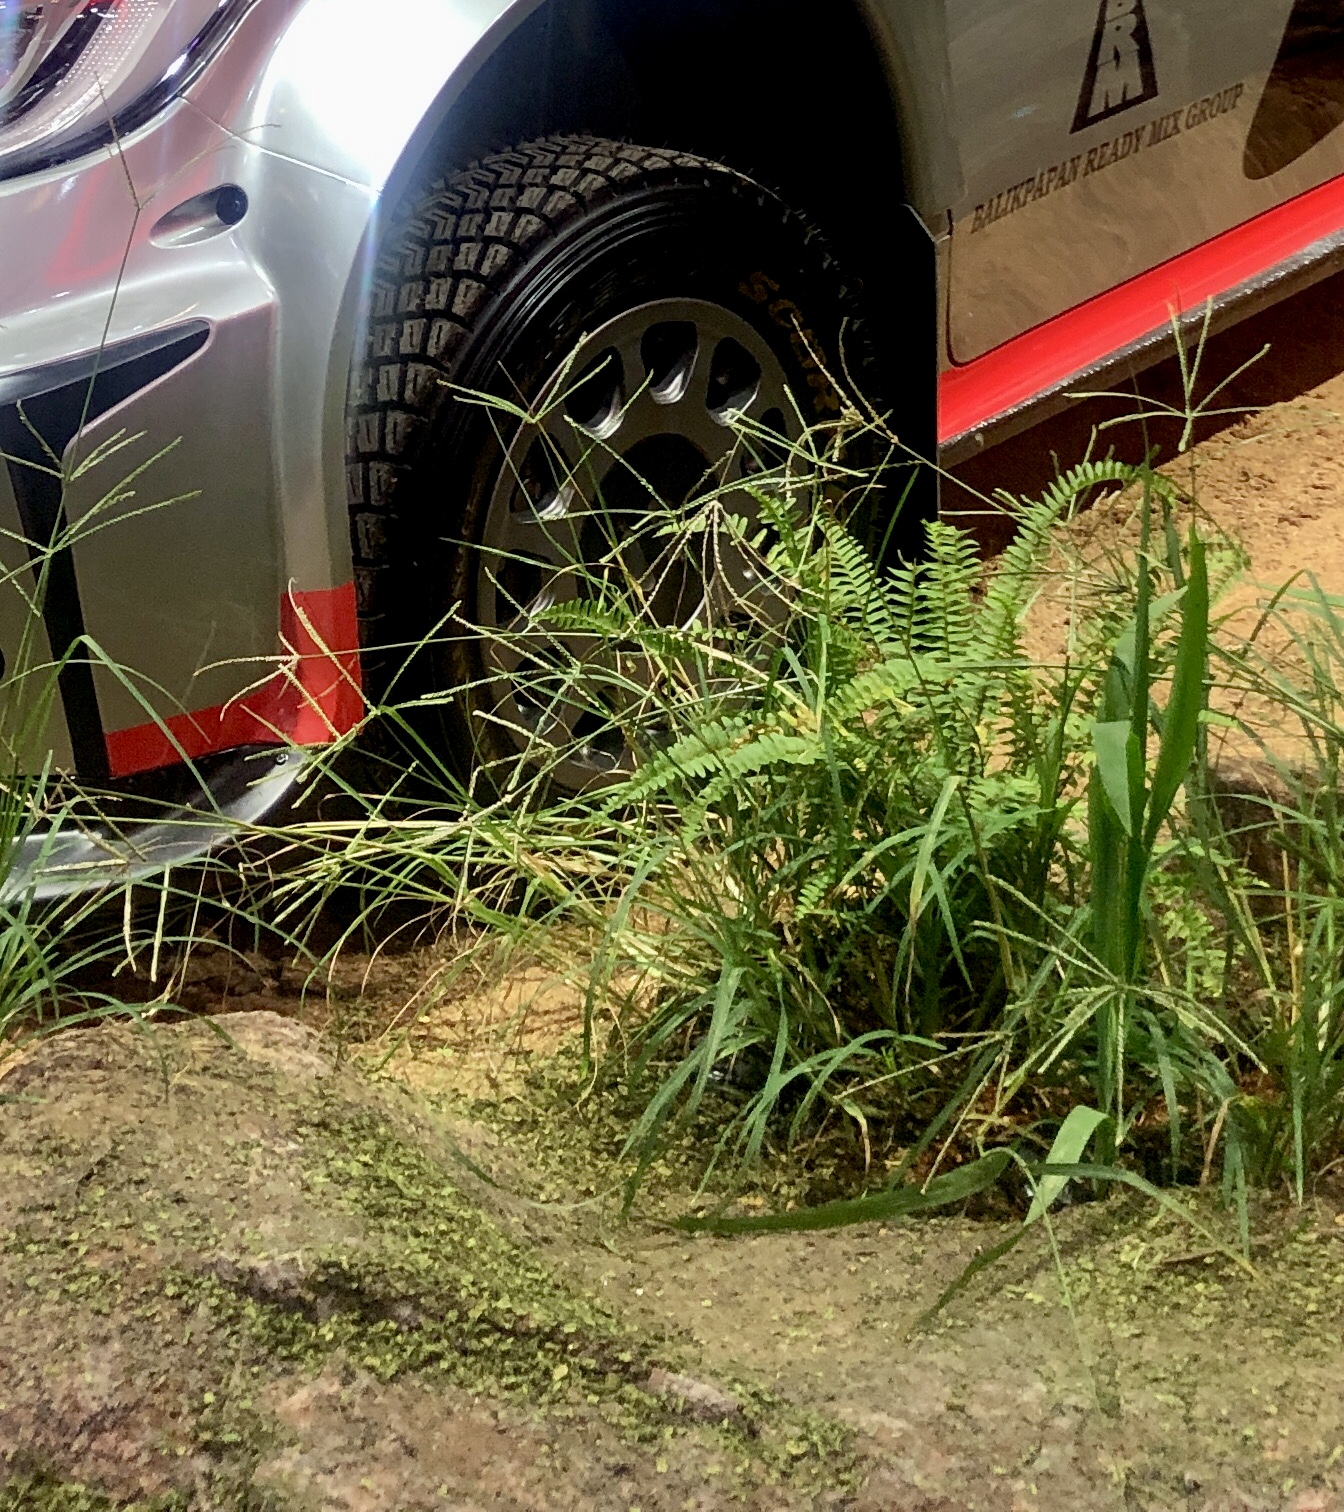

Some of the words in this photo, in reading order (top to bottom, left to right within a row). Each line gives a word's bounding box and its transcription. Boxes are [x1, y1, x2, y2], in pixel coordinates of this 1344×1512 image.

[1083, 125, 1146, 178] READY
[1146, 108, 1184, 148] MIX
[1185, 82, 1245, 130] GROUP
